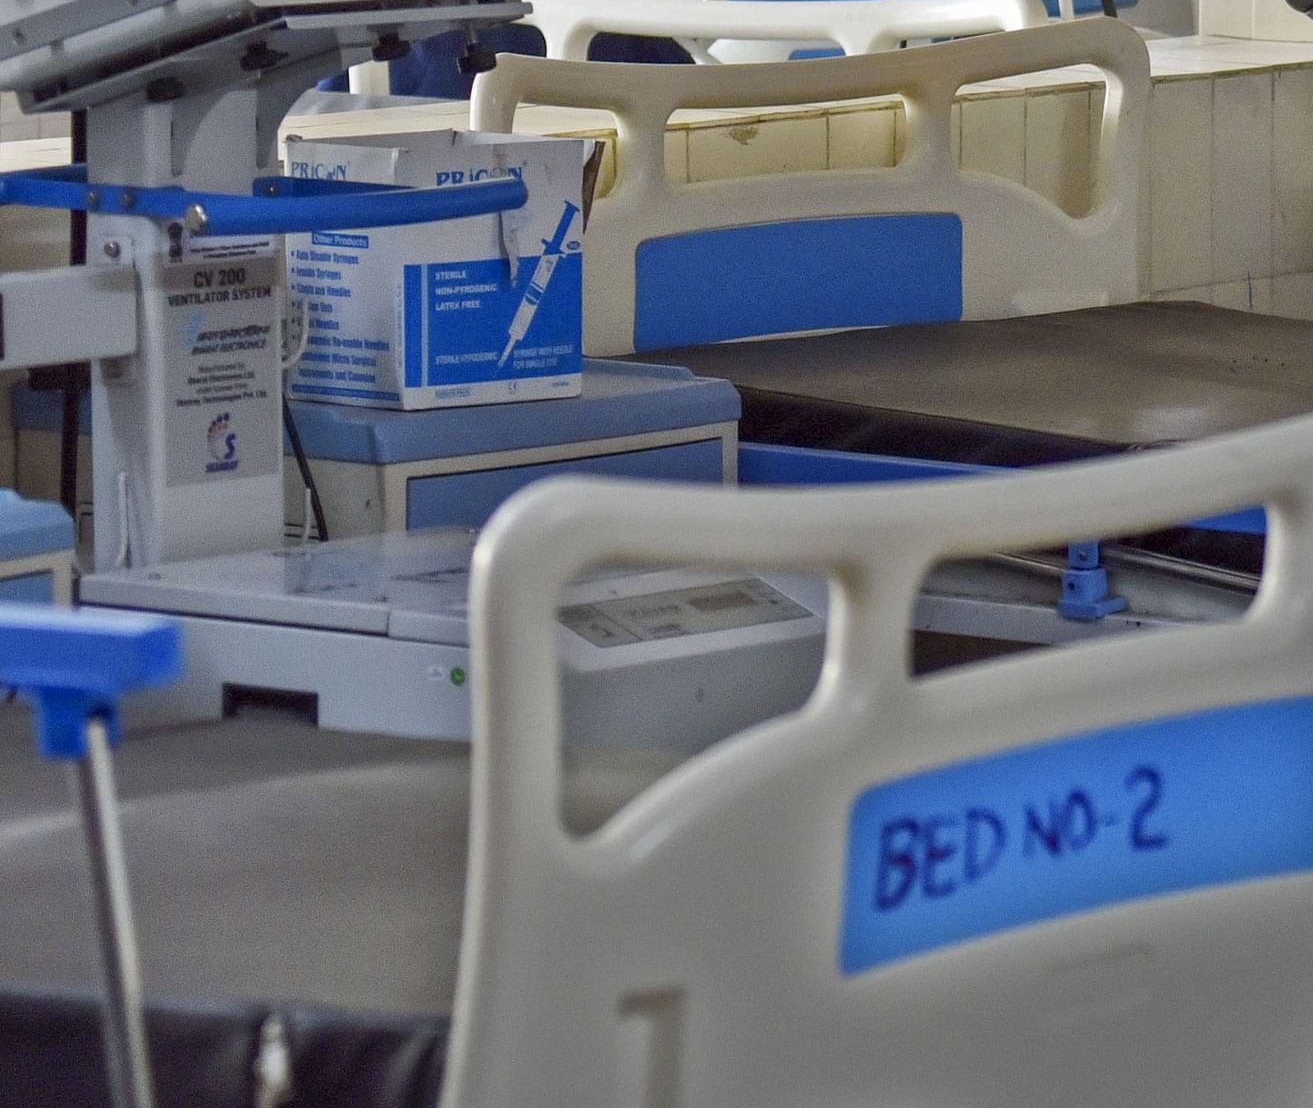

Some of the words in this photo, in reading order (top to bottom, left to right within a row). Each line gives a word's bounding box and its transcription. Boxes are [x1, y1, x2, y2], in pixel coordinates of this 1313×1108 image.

[194, 272, 213, 288] CV
[217, 268, 246, 287] 200
[168, 290, 230, 307] VENTILATOR
[231, 286, 271, 301] SYSTEM
[874, 806, 1007, 913] BED
